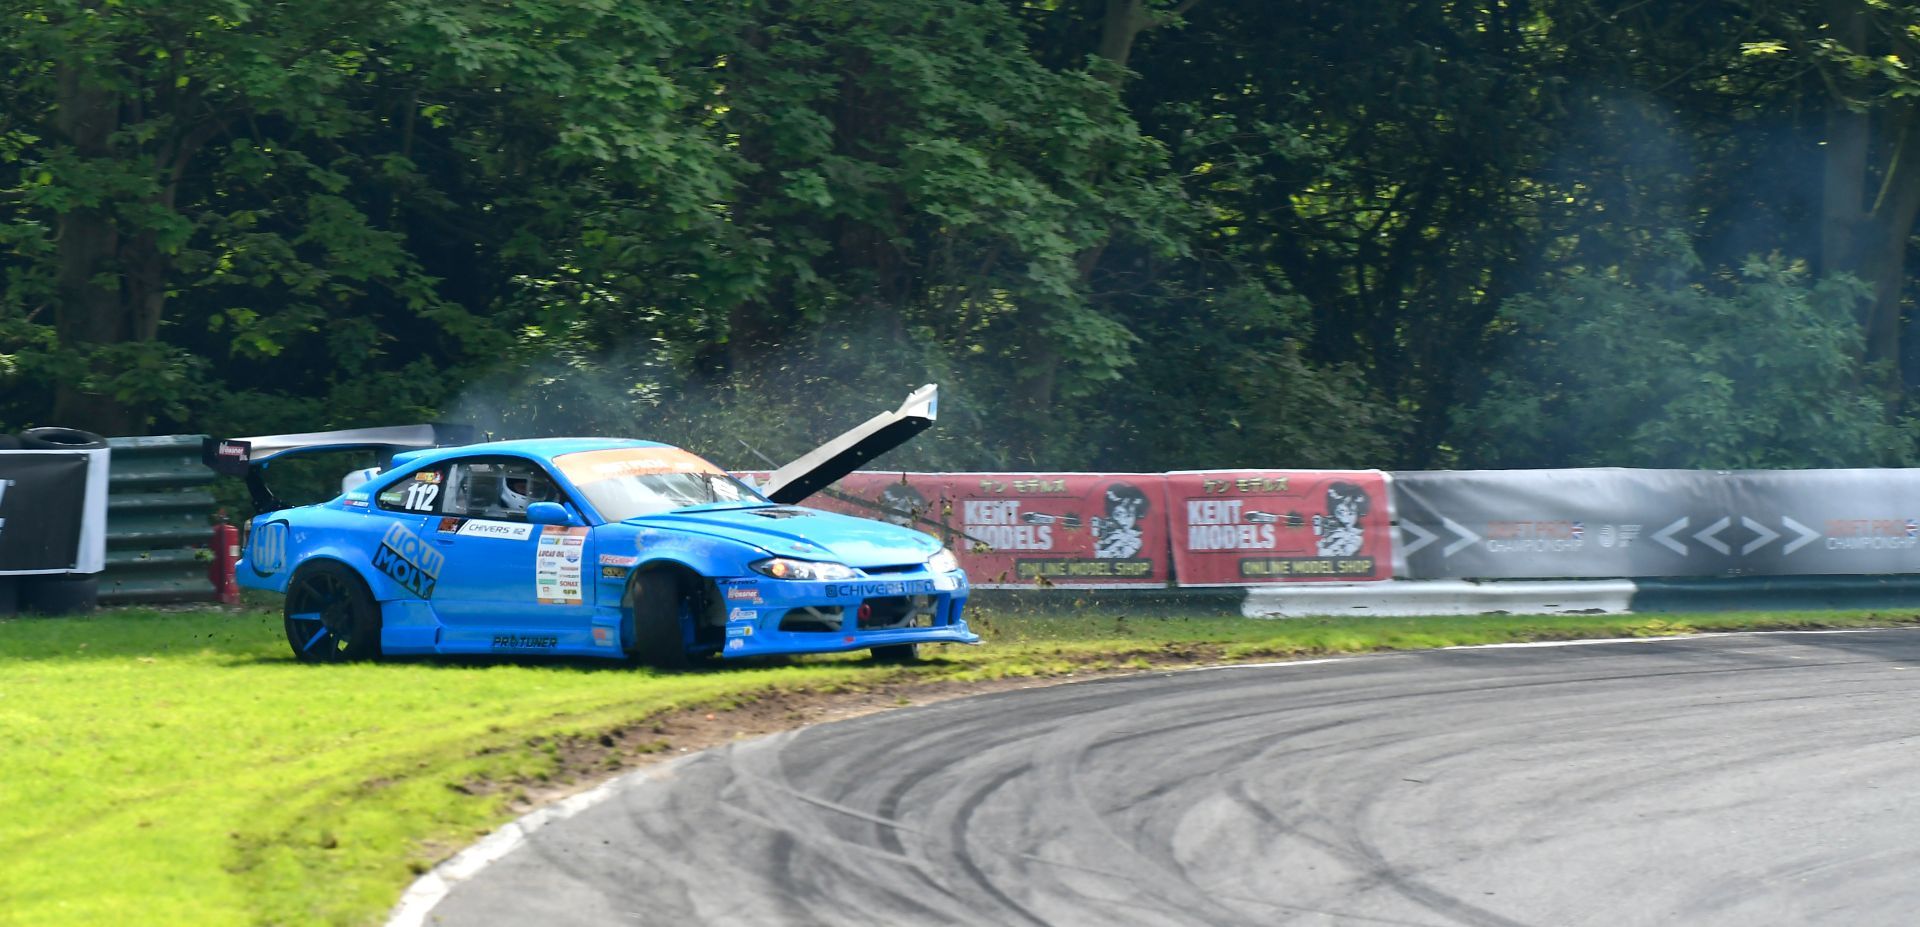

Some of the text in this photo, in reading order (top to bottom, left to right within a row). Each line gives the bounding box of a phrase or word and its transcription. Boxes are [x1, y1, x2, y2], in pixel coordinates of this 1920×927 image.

[405, 484, 440, 511] 112
[964, 501, 1020, 524] KENT
[1188, 500, 1243, 524] KENT
[468, 523, 510, 534] CHIVERS
[964, 525, 1053, 549] MODELS
[1189, 525, 1276, 549] MODELS
[384, 523, 443, 577] LIQUI
[375, 548, 434, 597] MOLY
[1019, 562, 1149, 576] ONLINE MODEL SHOP
[1243, 559, 1371, 575] ONLINE MODEL SHOP
